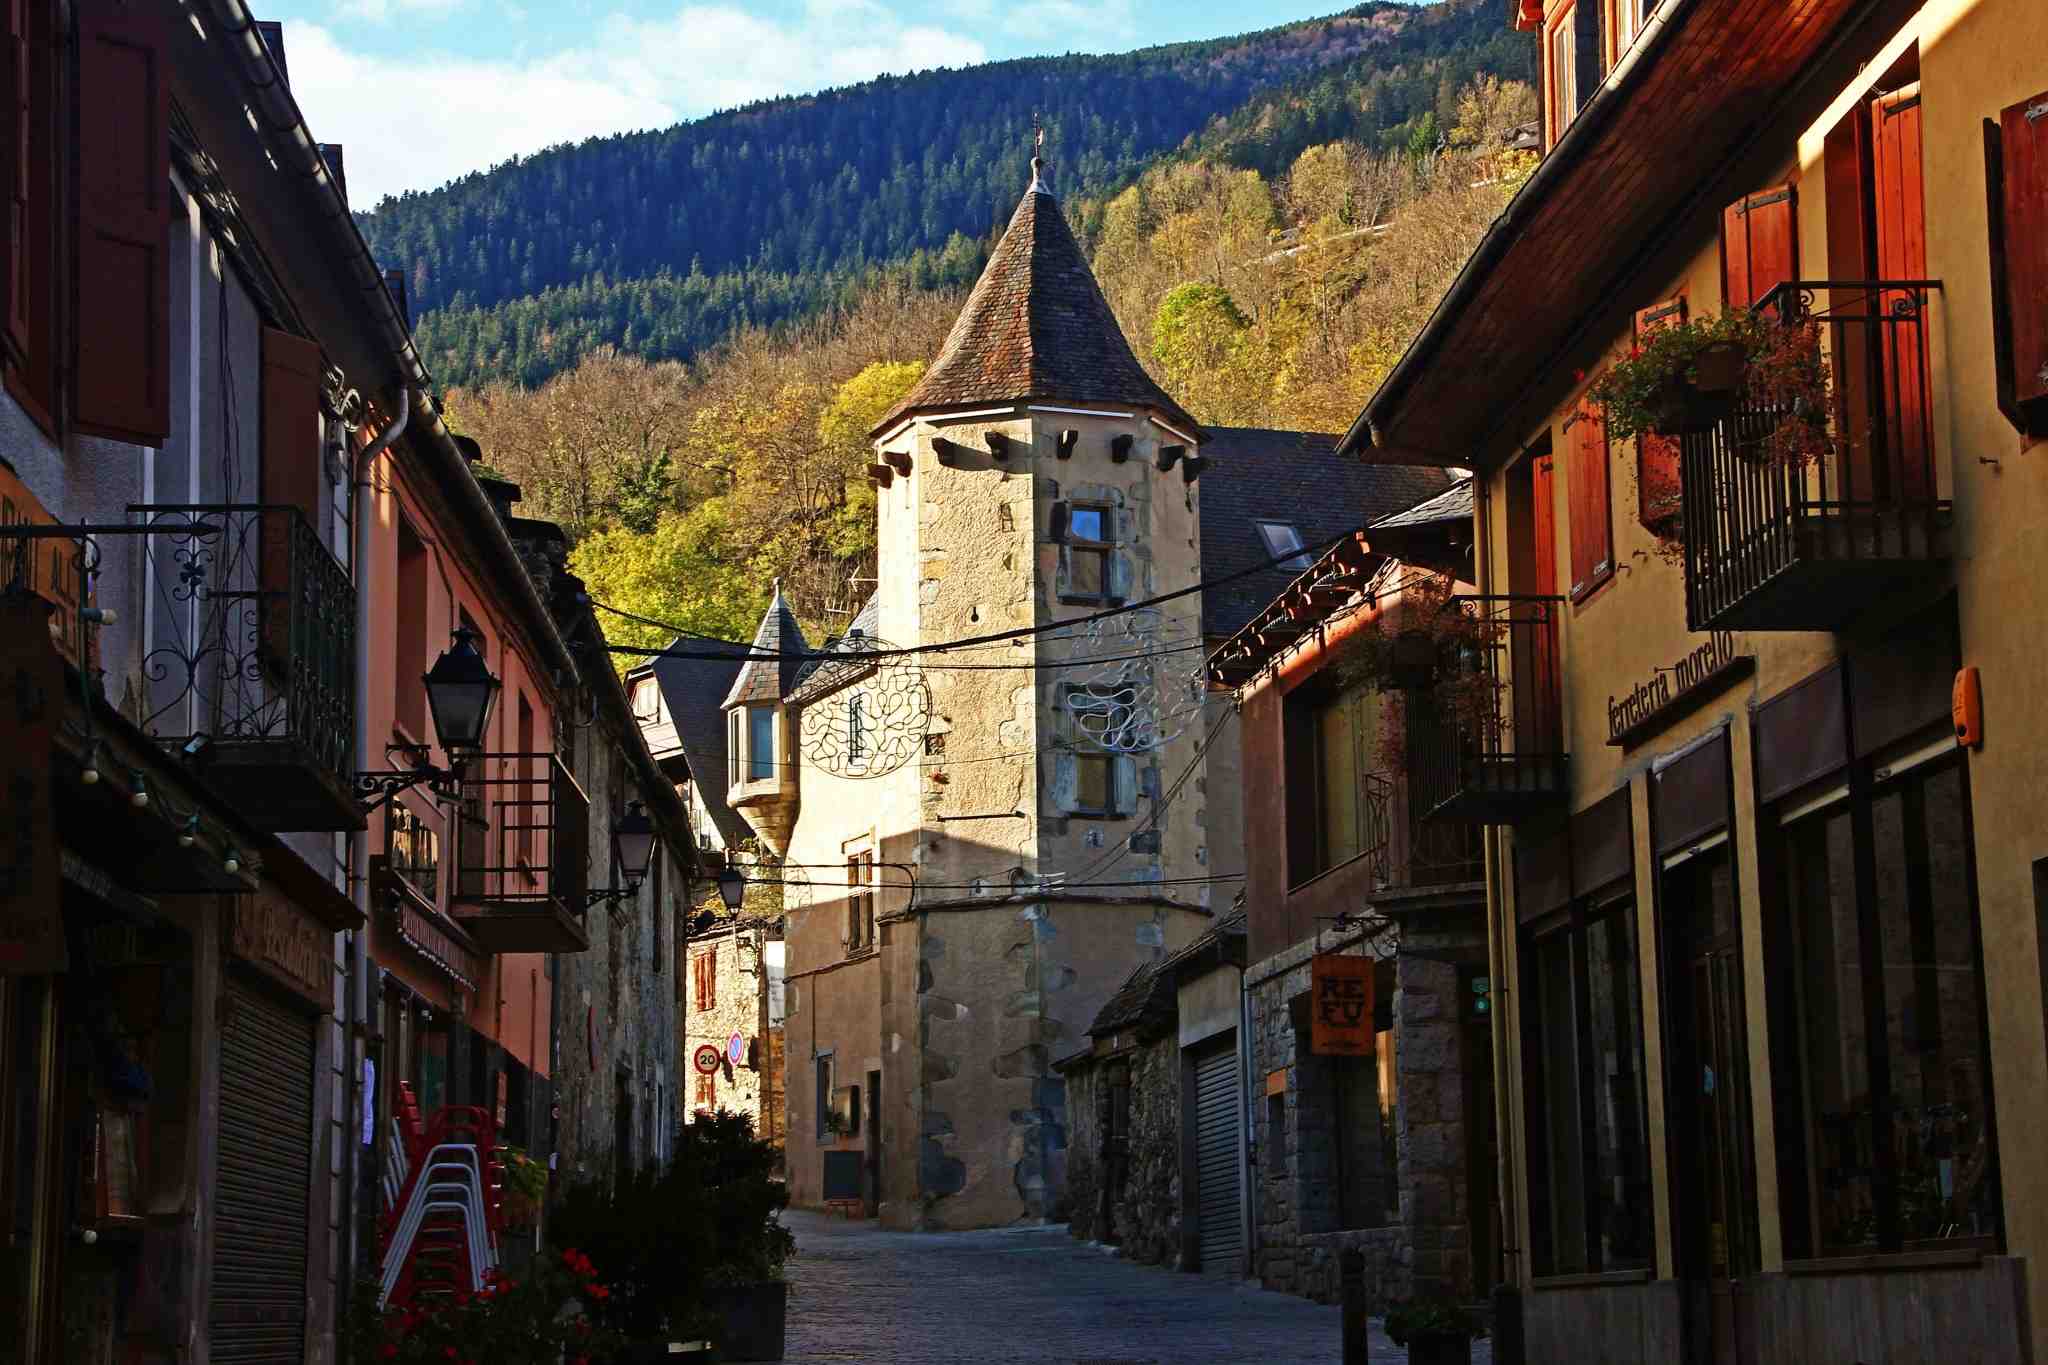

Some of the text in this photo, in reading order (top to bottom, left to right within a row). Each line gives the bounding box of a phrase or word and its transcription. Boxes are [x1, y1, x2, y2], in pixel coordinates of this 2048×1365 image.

[1675, 630, 1733, 691] morello
[1319, 976, 1365, 998] RE
[700, 1054, 715, 1065] 20
